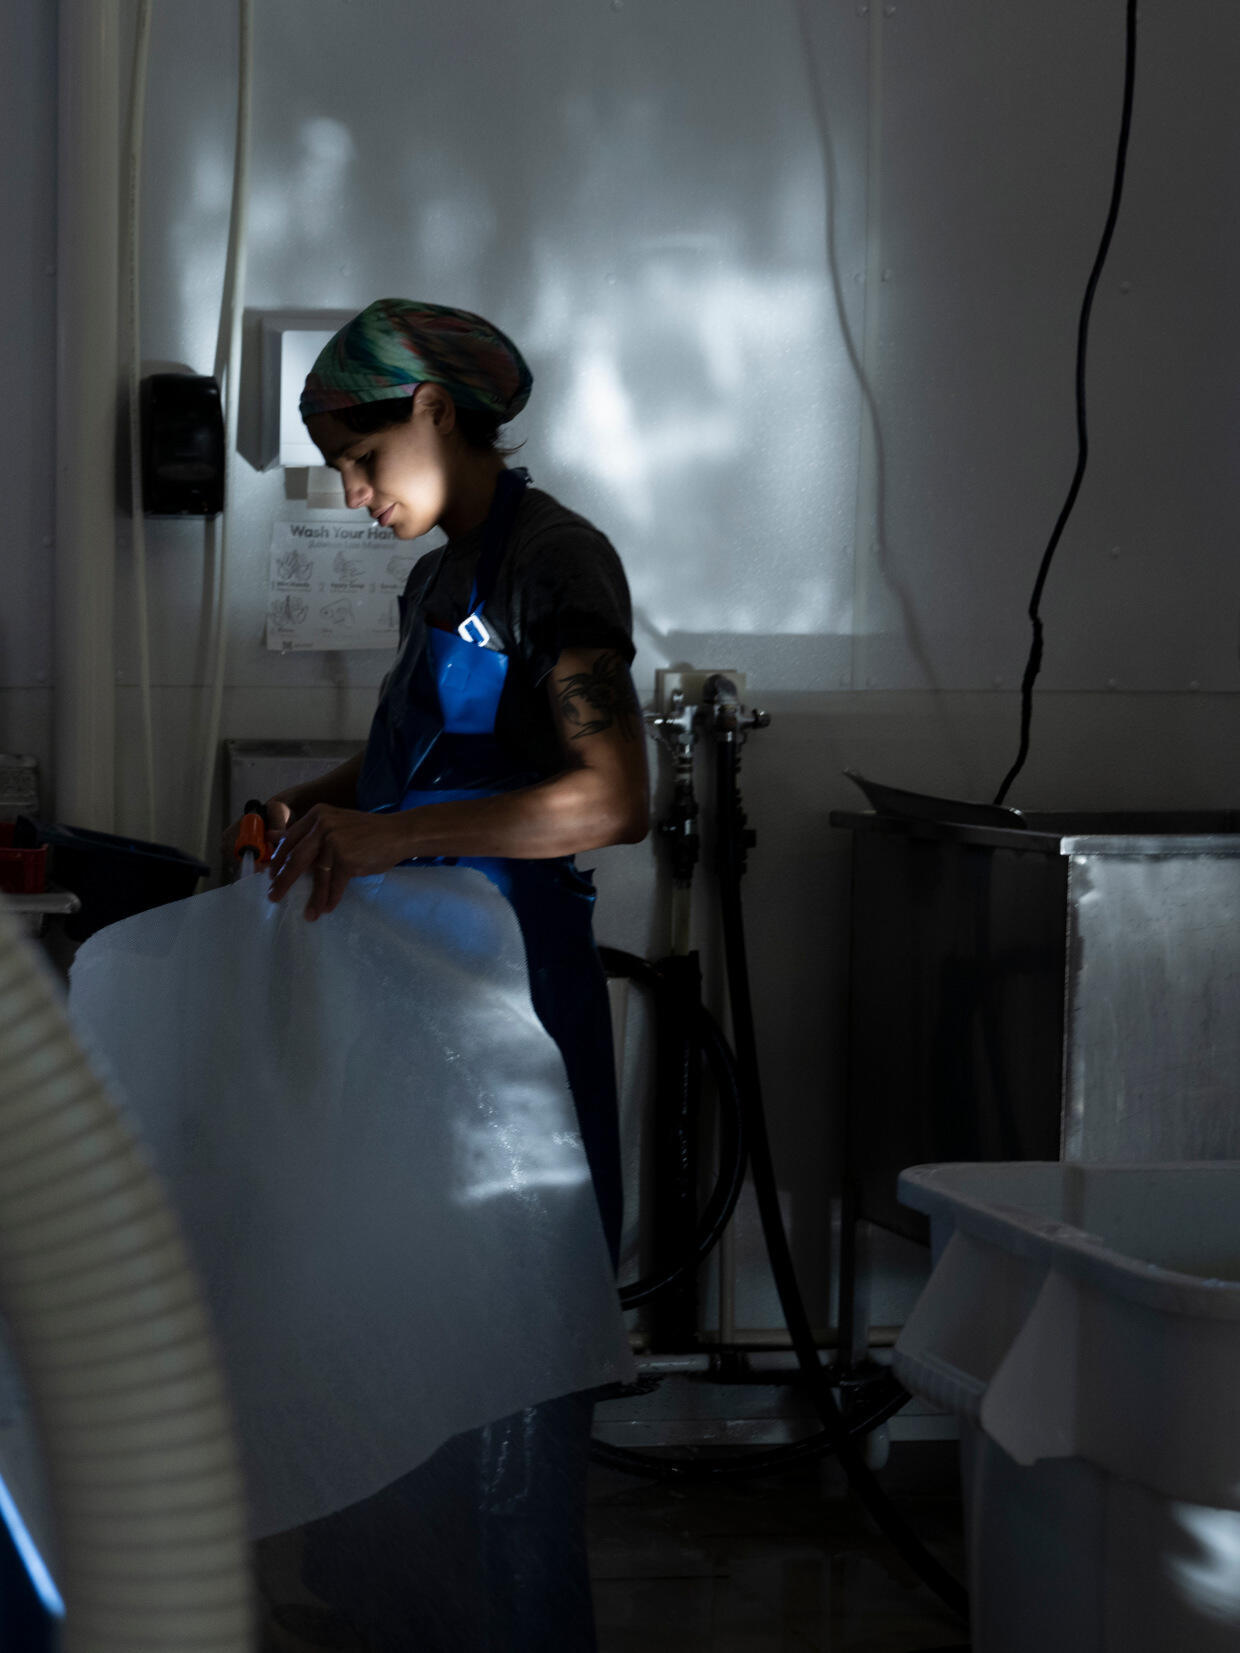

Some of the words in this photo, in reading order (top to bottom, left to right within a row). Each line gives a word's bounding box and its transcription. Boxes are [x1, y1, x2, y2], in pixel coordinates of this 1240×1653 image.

[290, 524, 329, 538] Wash
[333, 526, 365, 539] Your
[367, 527, 394, 540] Han
